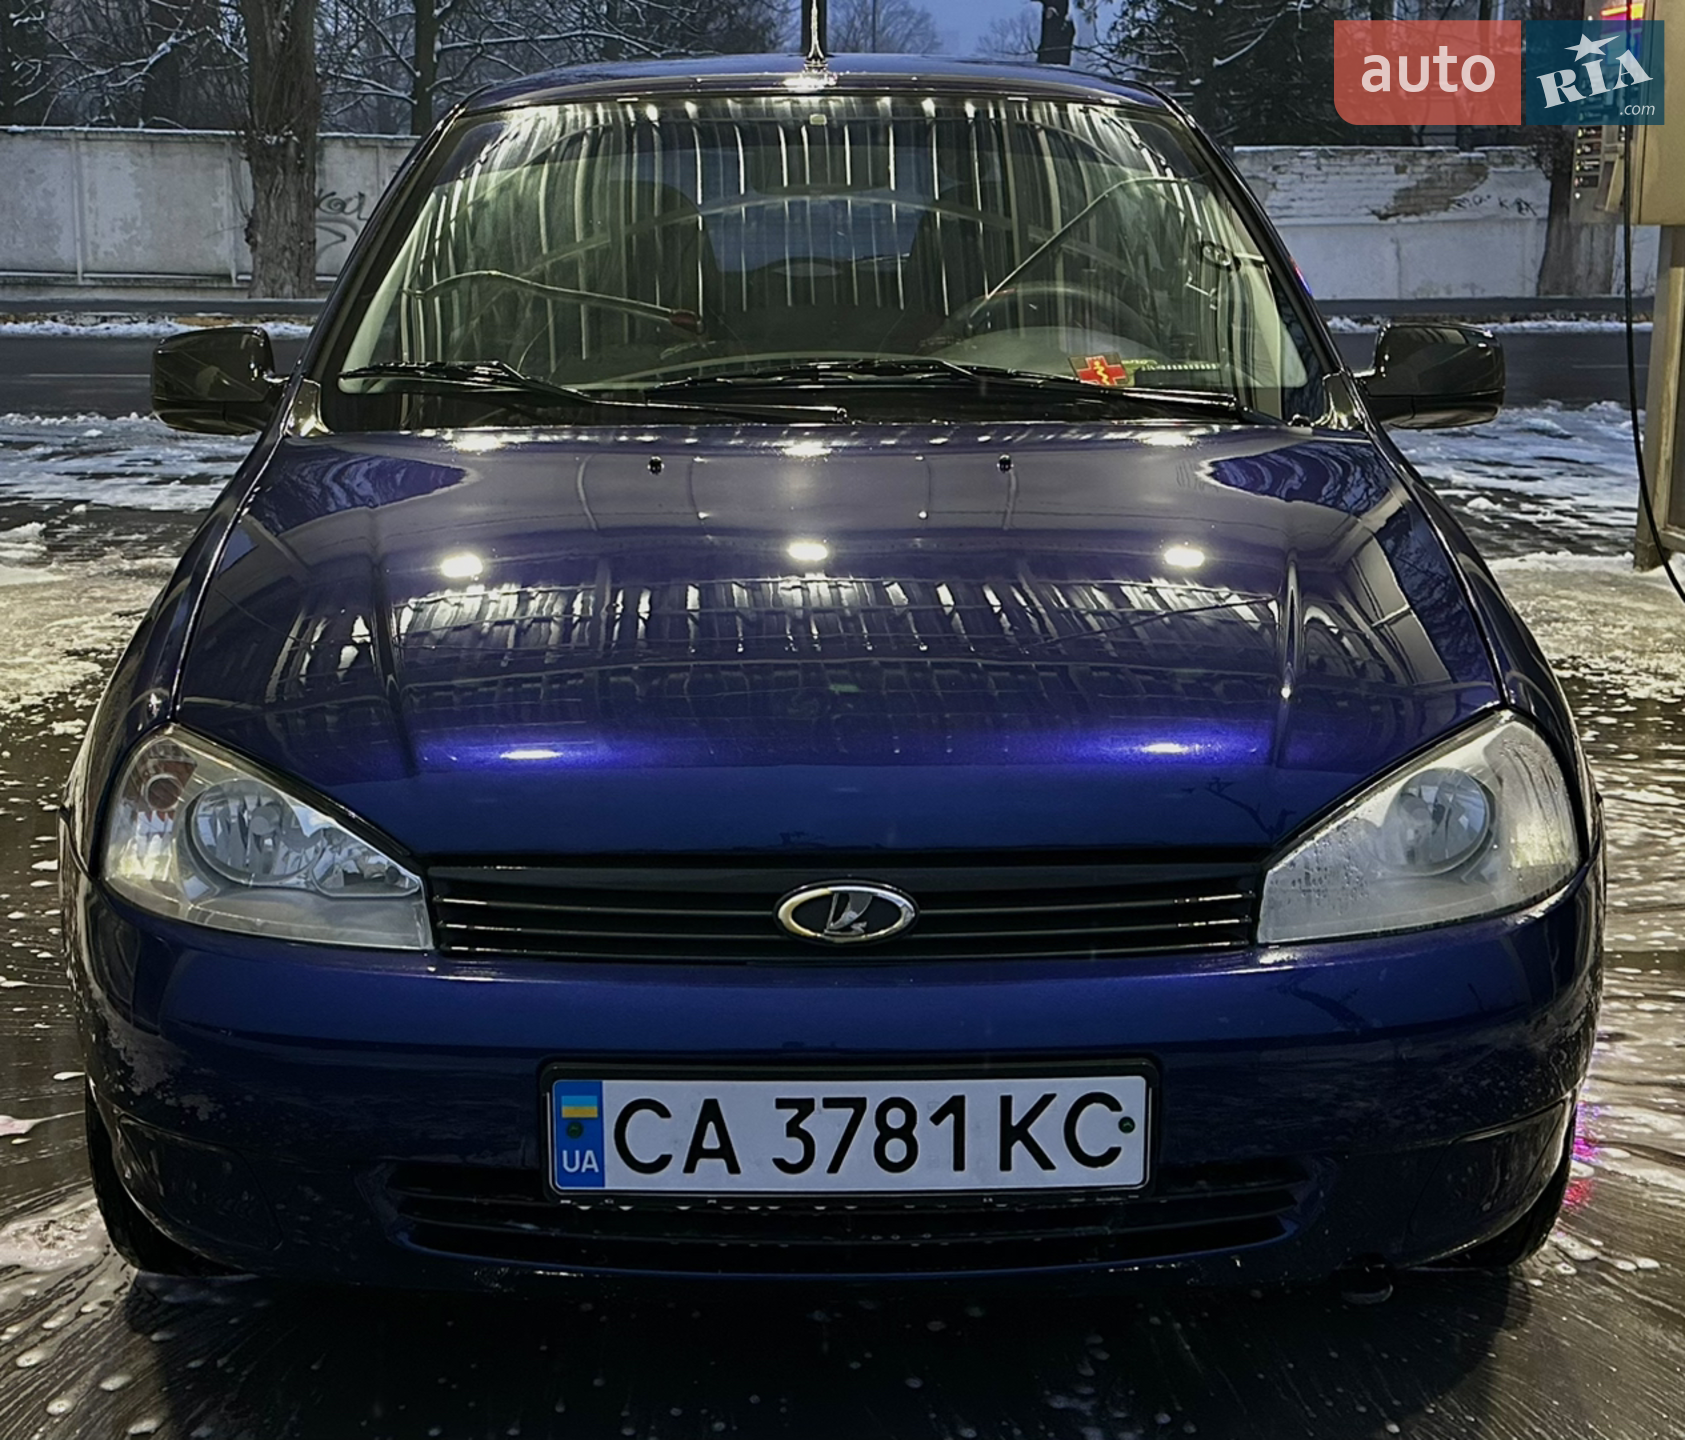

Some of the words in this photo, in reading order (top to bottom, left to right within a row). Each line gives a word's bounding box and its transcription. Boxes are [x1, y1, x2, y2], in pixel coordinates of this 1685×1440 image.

[613, 1097, 742, 1175] CA
[771, 1094, 967, 1175] 3781
[999, 1091, 1124, 1173] KC
[562, 1149, 600, 1173] UA
